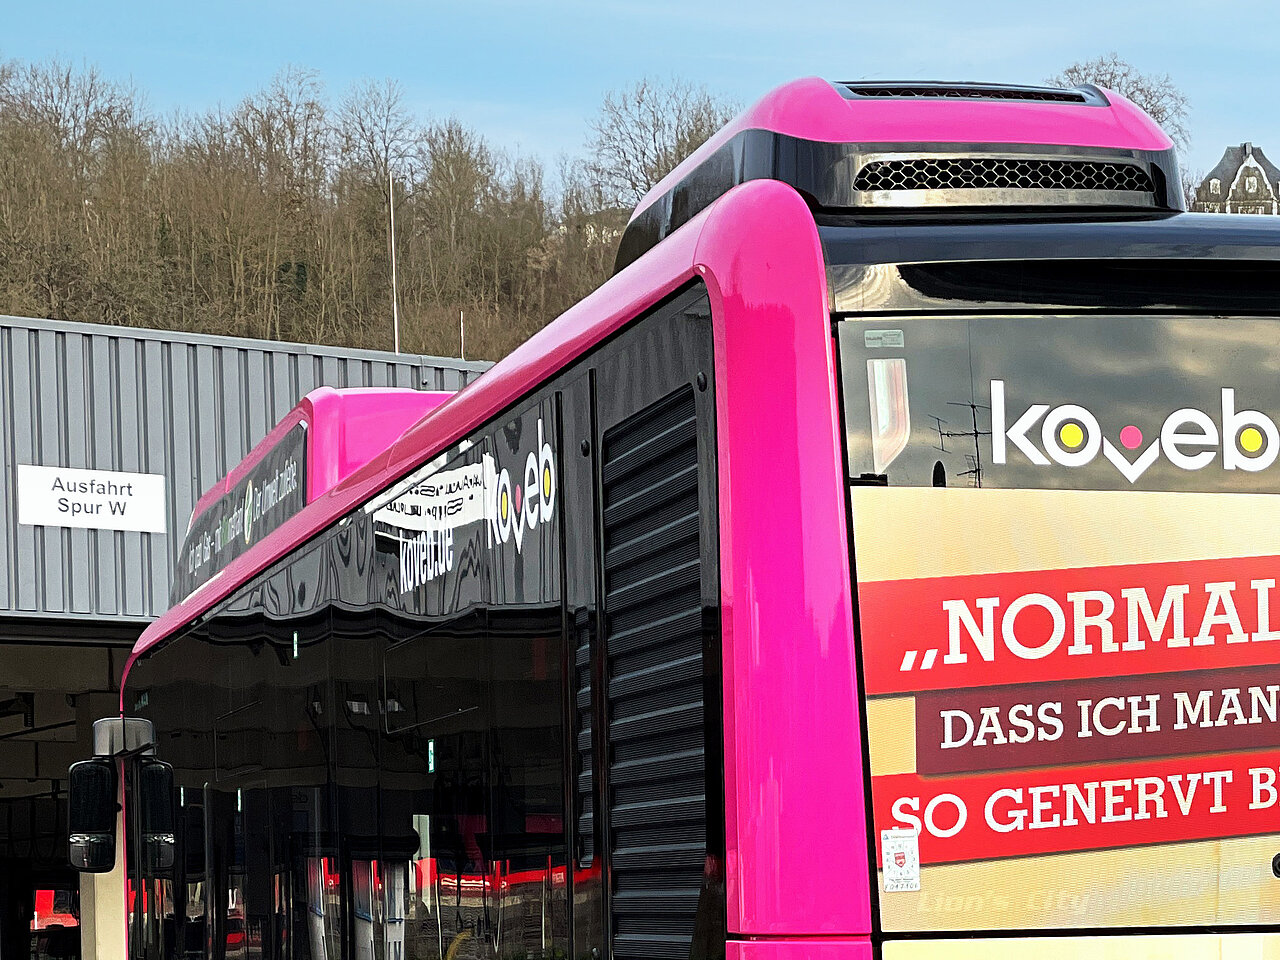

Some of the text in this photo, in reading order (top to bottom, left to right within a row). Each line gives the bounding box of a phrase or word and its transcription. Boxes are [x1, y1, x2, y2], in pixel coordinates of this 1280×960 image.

[989, 378, 1280, 484] koveb
[51, 476, 133, 497] Ausfahrt
[57, 497, 127, 517] Spur W
[482, 418, 556, 554] koveb
[940, 701, 1064, 750] DASS
[1076, 693, 1161, 739] ICH
[891, 792, 968, 840] SO
[984, 769, 1234, 833] GENERVT
